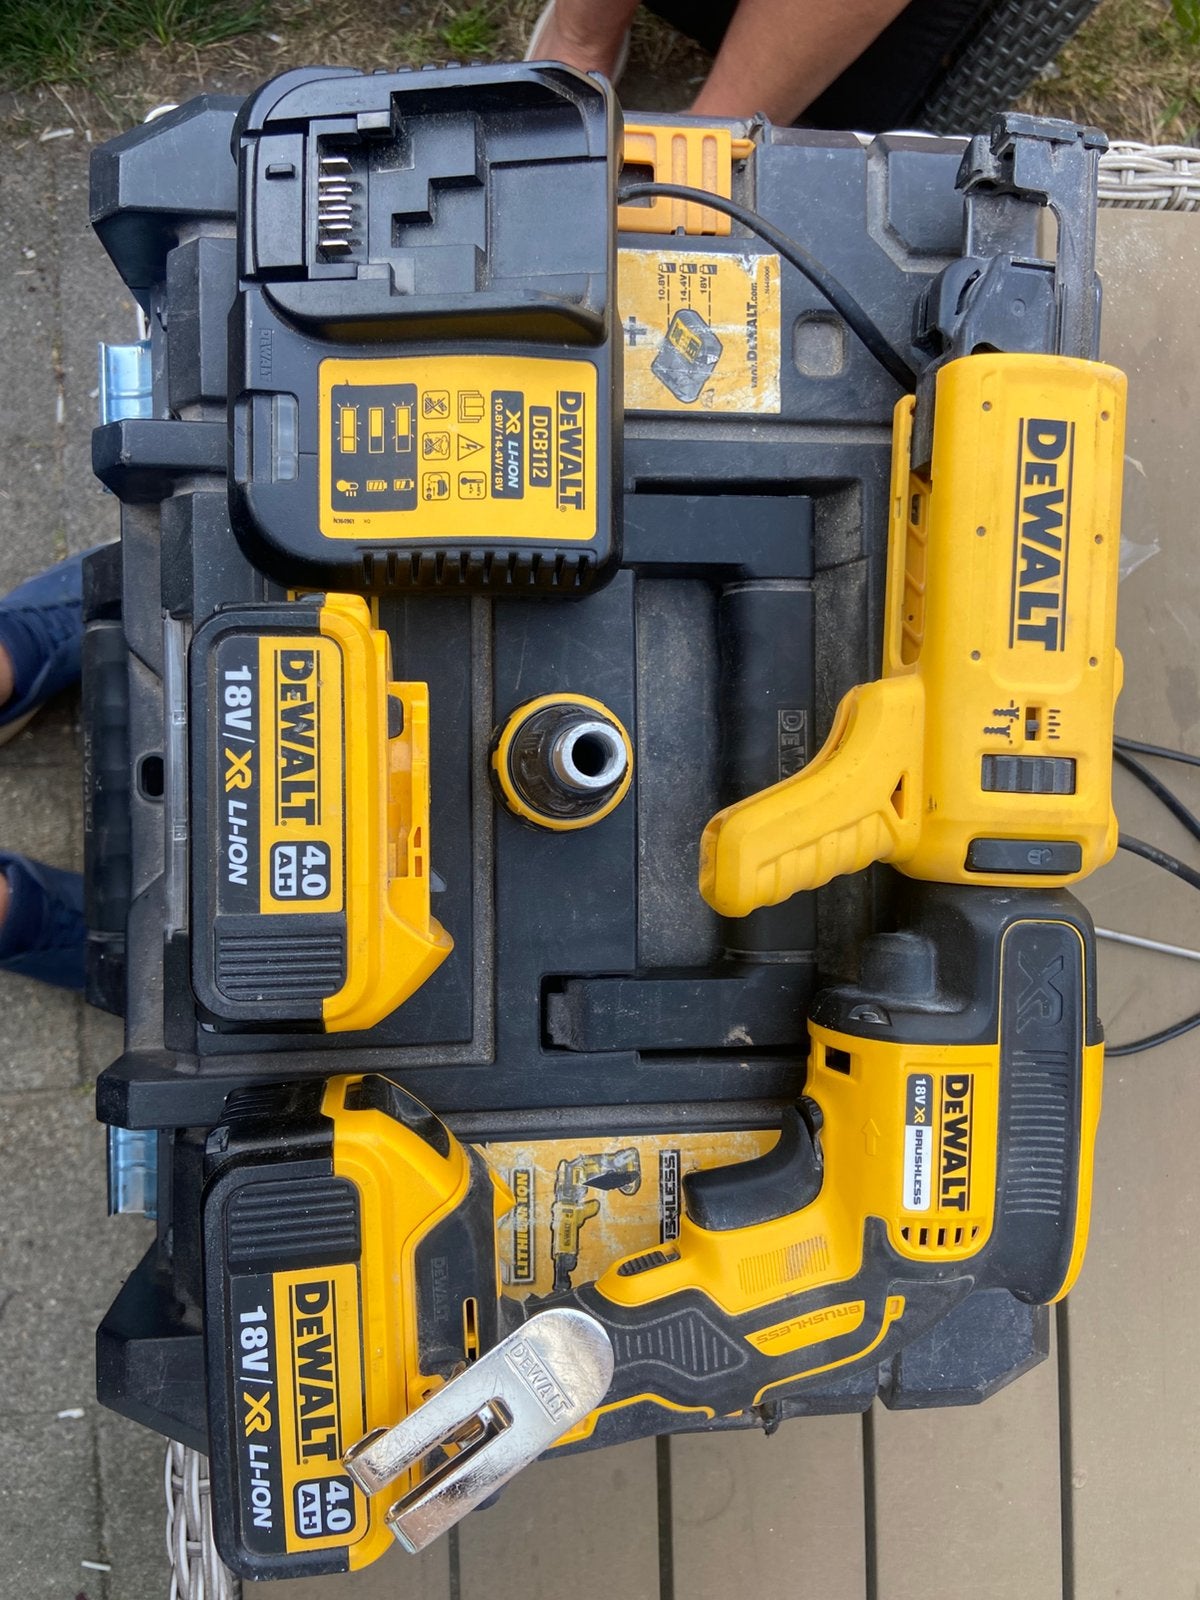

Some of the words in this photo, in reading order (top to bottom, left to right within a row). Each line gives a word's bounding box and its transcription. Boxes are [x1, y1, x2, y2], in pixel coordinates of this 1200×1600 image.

[506, 409, 521, 435] XR
[532, 415, 549, 478] DCB112
[508, 440, 519, 488] LI-ION
[1017, 418, 1068, 651] DEWALT
[780, 709, 805, 776] DEW
[228, 799, 247, 885] LI-ION
[278, 849, 293, 894] AH
[302, 845, 327, 896] 4.0
[914, 1077, 926, 1104] 18V
[913, 1129, 923, 1205] BRUSHLESS
[942, 1074, 969, 1212] DEWALT
[516, 1172, 528, 1204] ION
[756, 1305, 861, 1345] BRUSHLESS
[509, 1341, 569, 1422] DEWALT
[248, 1444, 272, 1528] LI-ION
[301, 1489, 317, 1530] AH
[325, 1480, 351, 1531] 4.0
